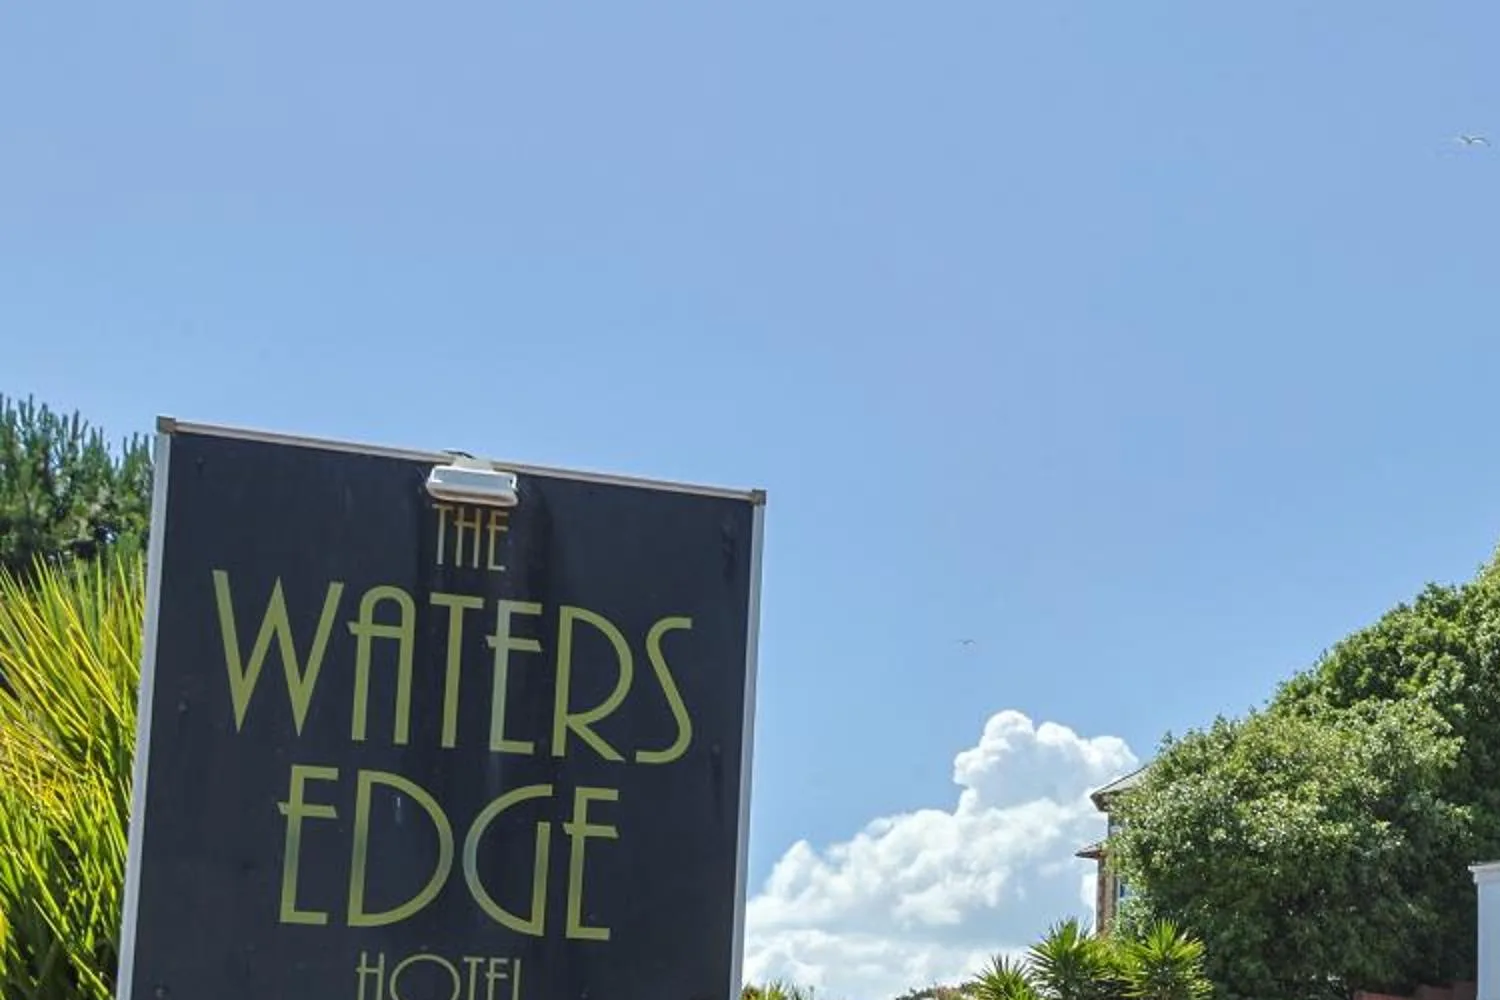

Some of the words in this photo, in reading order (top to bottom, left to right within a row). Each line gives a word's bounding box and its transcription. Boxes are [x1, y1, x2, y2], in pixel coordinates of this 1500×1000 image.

[431, 503, 509, 571] THE
[213, 569, 693, 763] WATERS
[278, 764, 620, 941] EDGE
